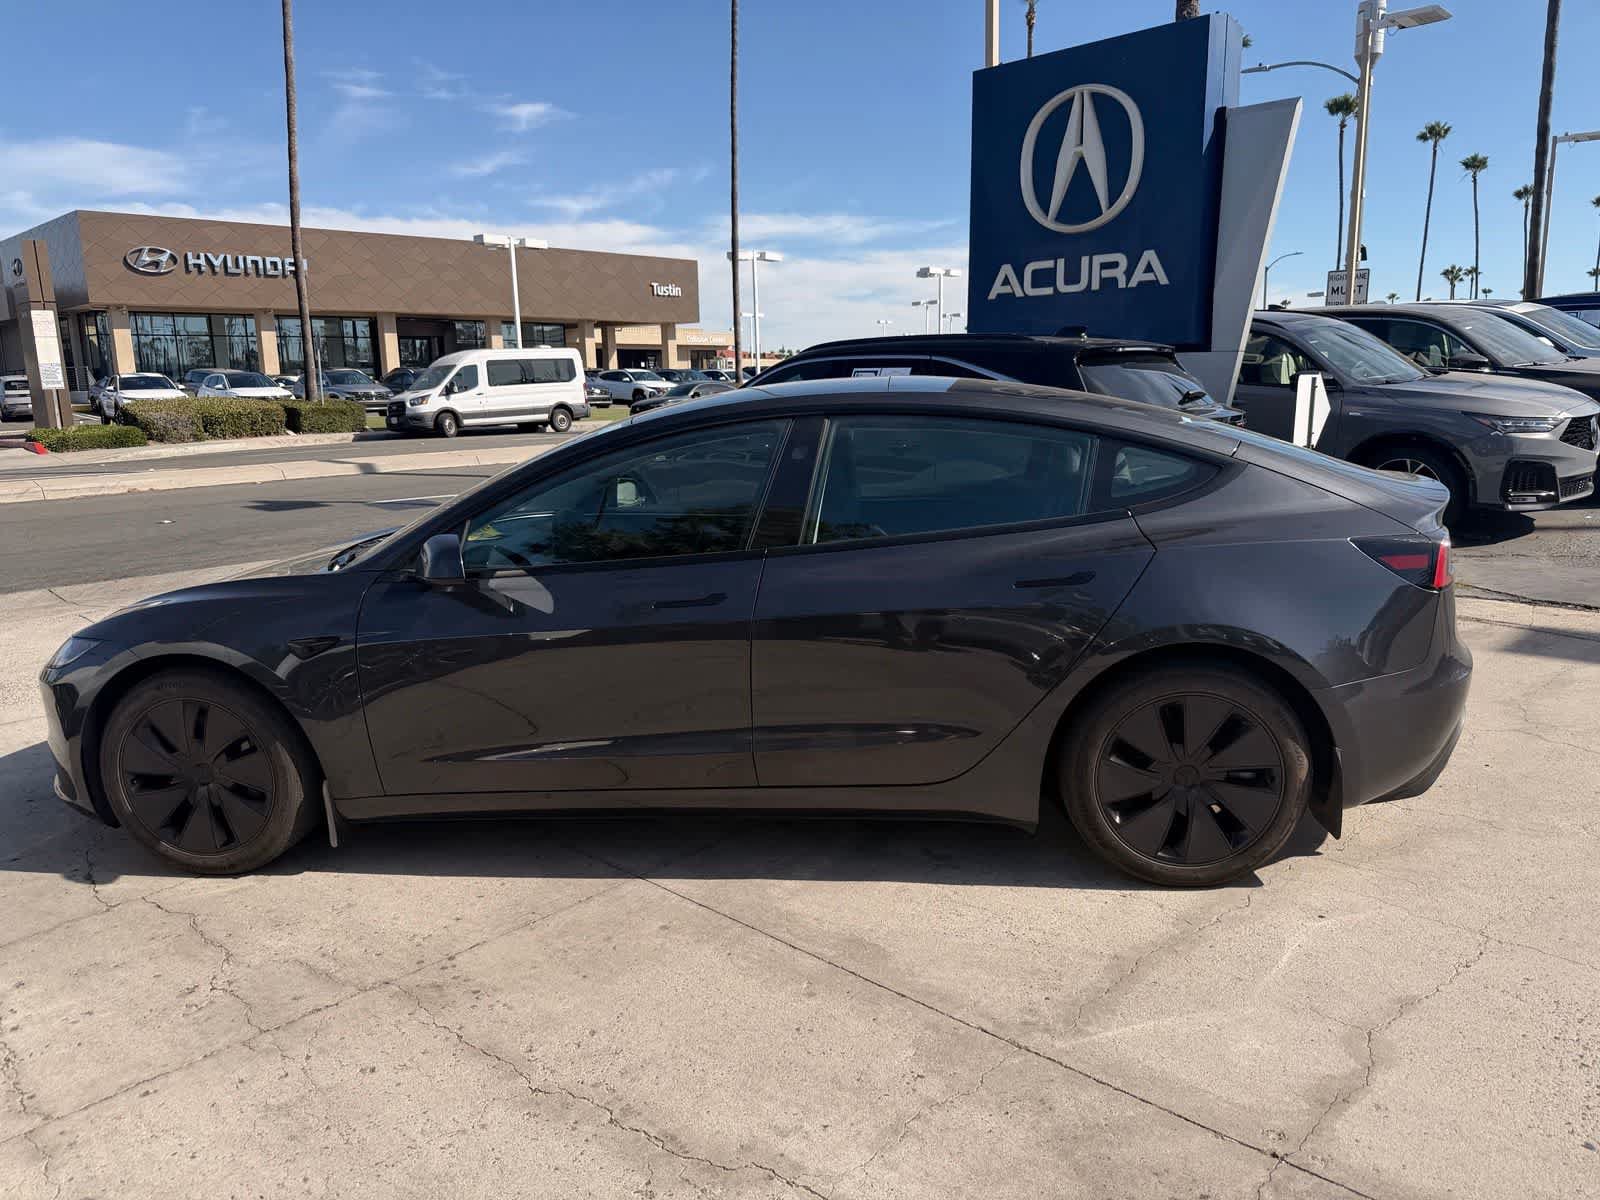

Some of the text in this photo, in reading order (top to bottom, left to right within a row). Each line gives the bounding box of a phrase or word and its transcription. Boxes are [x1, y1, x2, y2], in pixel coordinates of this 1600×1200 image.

[987, 249, 1162, 301] ACURA
[650, 282, 682, 297] Tustin
[1331, 285, 1363, 295] MUT
